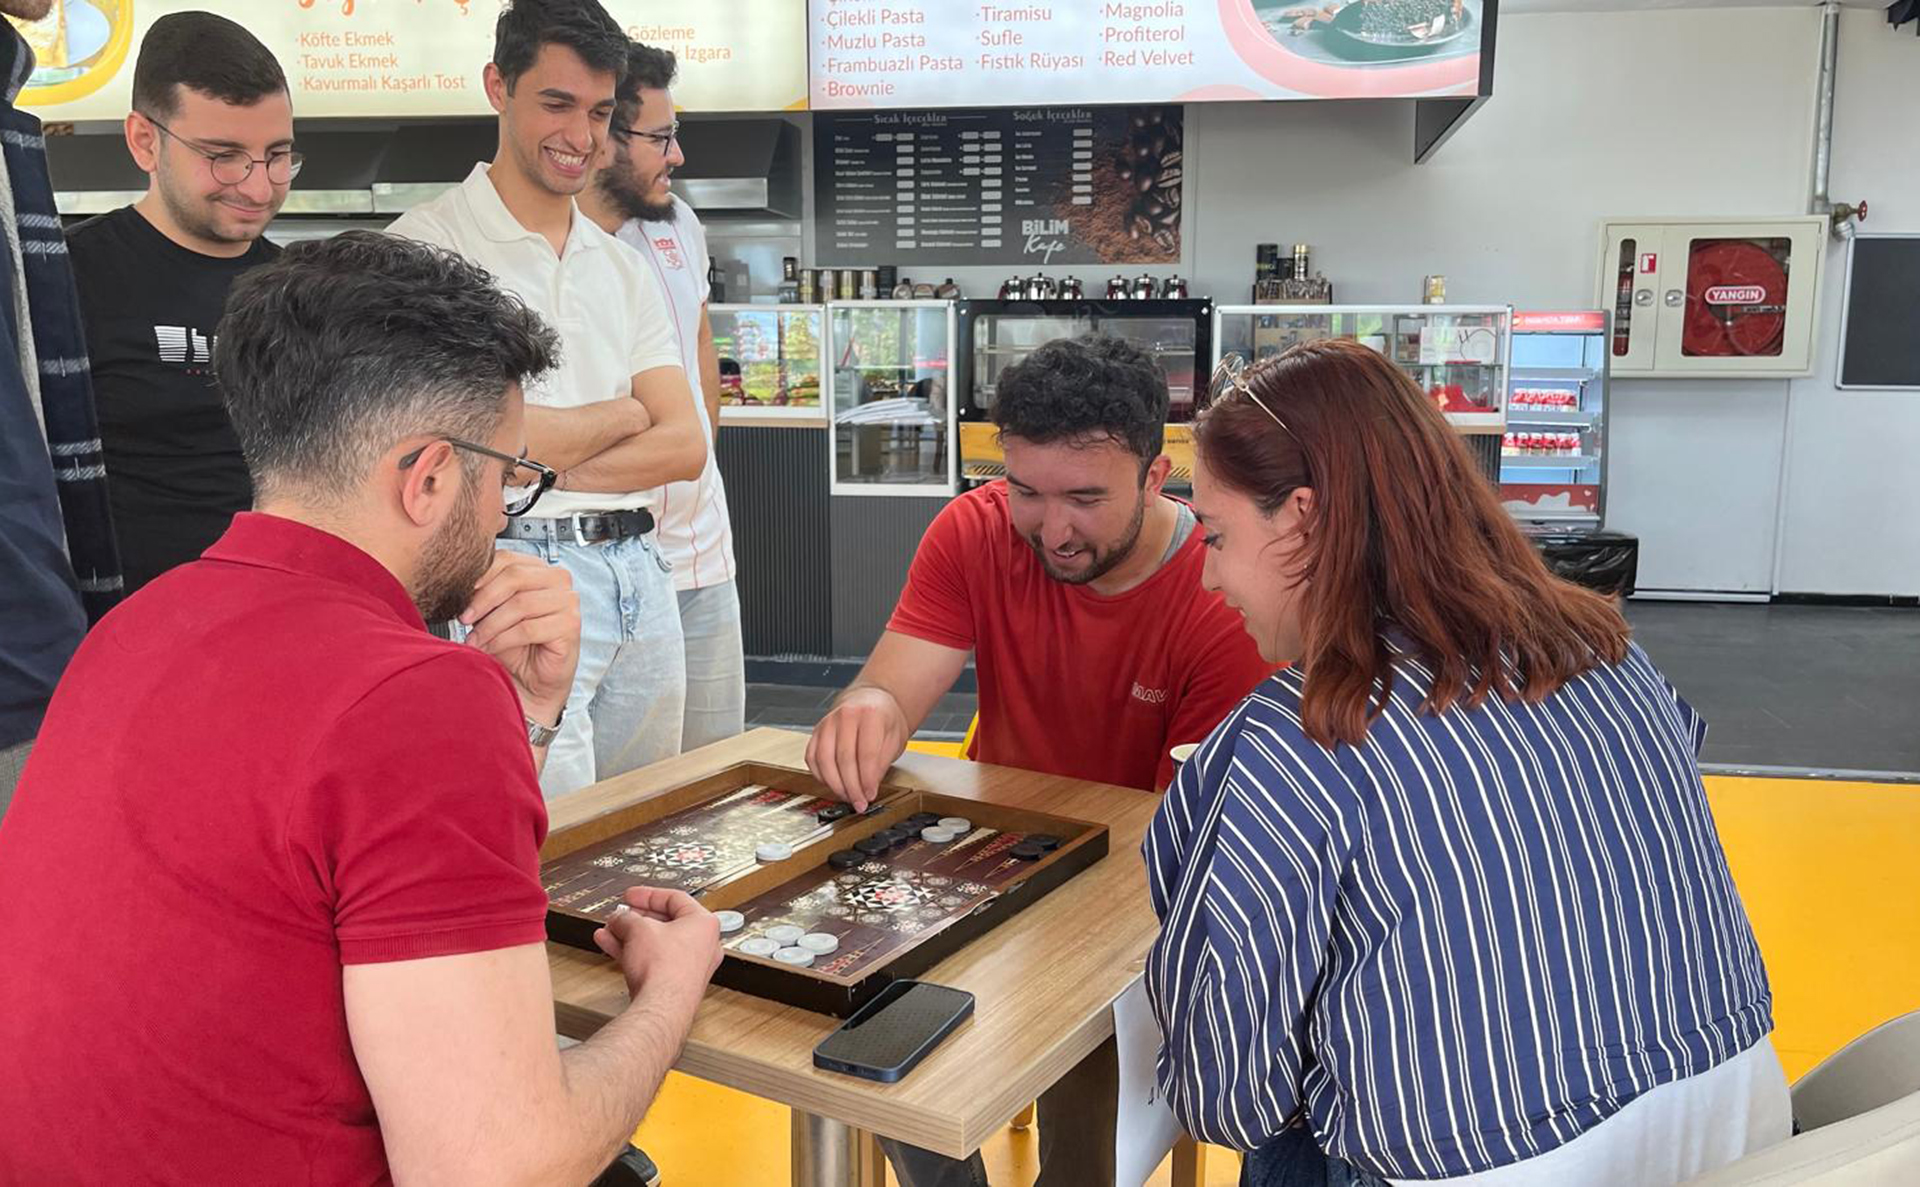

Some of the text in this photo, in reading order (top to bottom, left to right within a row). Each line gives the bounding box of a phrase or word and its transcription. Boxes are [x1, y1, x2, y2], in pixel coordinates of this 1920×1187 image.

[827, 9, 925, 29] Çilekli Pasta
[981, 5, 1052, 22] Tiramisu
[1105, 2, 1184, 21] Magnolia
[300, 32, 395, 47] Köfte Ekmek
[628, 26, 696, 41] Gözleme
[827, 33, 926, 50] Muzlu Pasta
[981, 29, 1023, 46] Sufle
[1105, 25, 1185, 43] Profiterol
[303, 53, 399, 69] Tavuk Ekmek
[685, 45, 731, 63] Izgara
[981, 52, 1084, 72] Fıstık Rüyası
[1105, 49, 1195, 67] Red Velvet
[827, 55, 963, 73] Frambuazlı Pasta
[304, 74, 467, 92] Kavurmalı Kaşarlı Tost
[828, 80, 895, 97] Brownie
[1711, 290, 1760, 300] YANGIN
